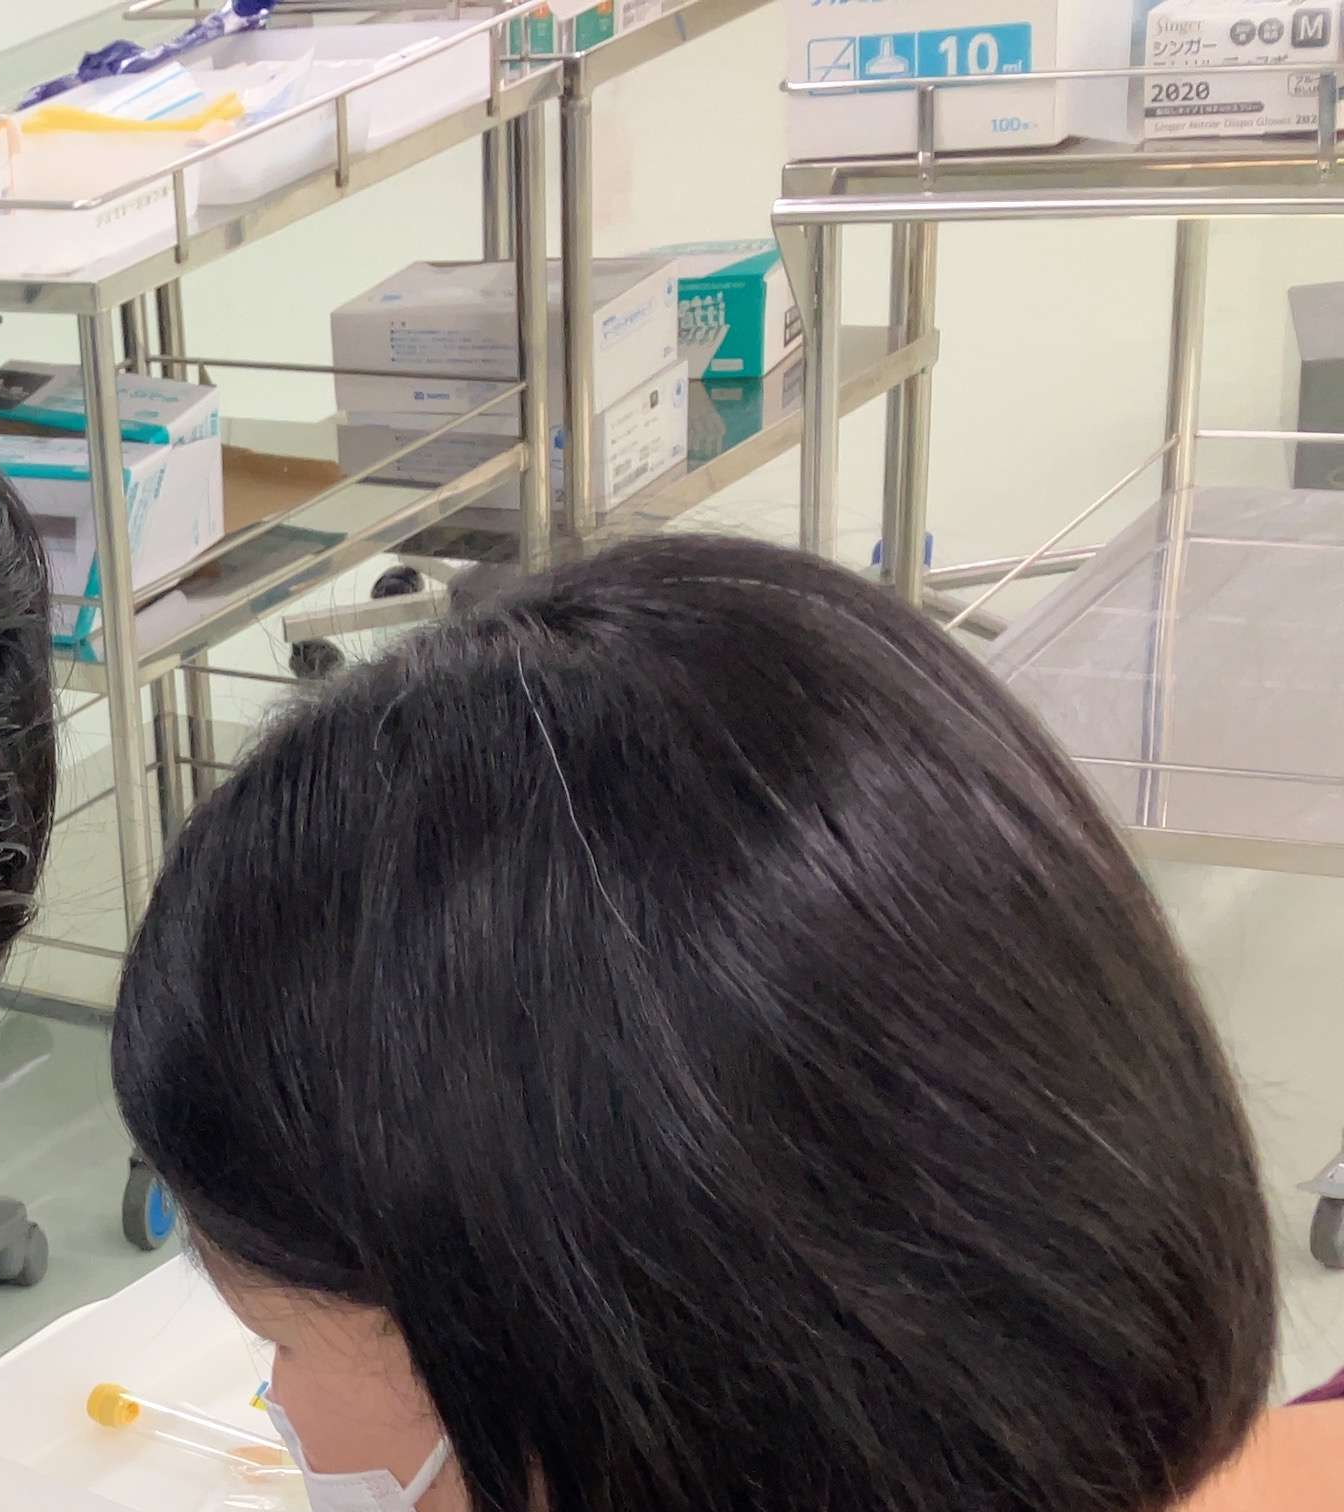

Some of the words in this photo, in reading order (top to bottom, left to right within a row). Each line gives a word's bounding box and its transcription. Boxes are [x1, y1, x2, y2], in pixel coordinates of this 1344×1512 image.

[1300, 14, 1324, 40] M
[1153, 36, 1217, 56] シンガー
[1151, 81, 1210, 103] 2020
